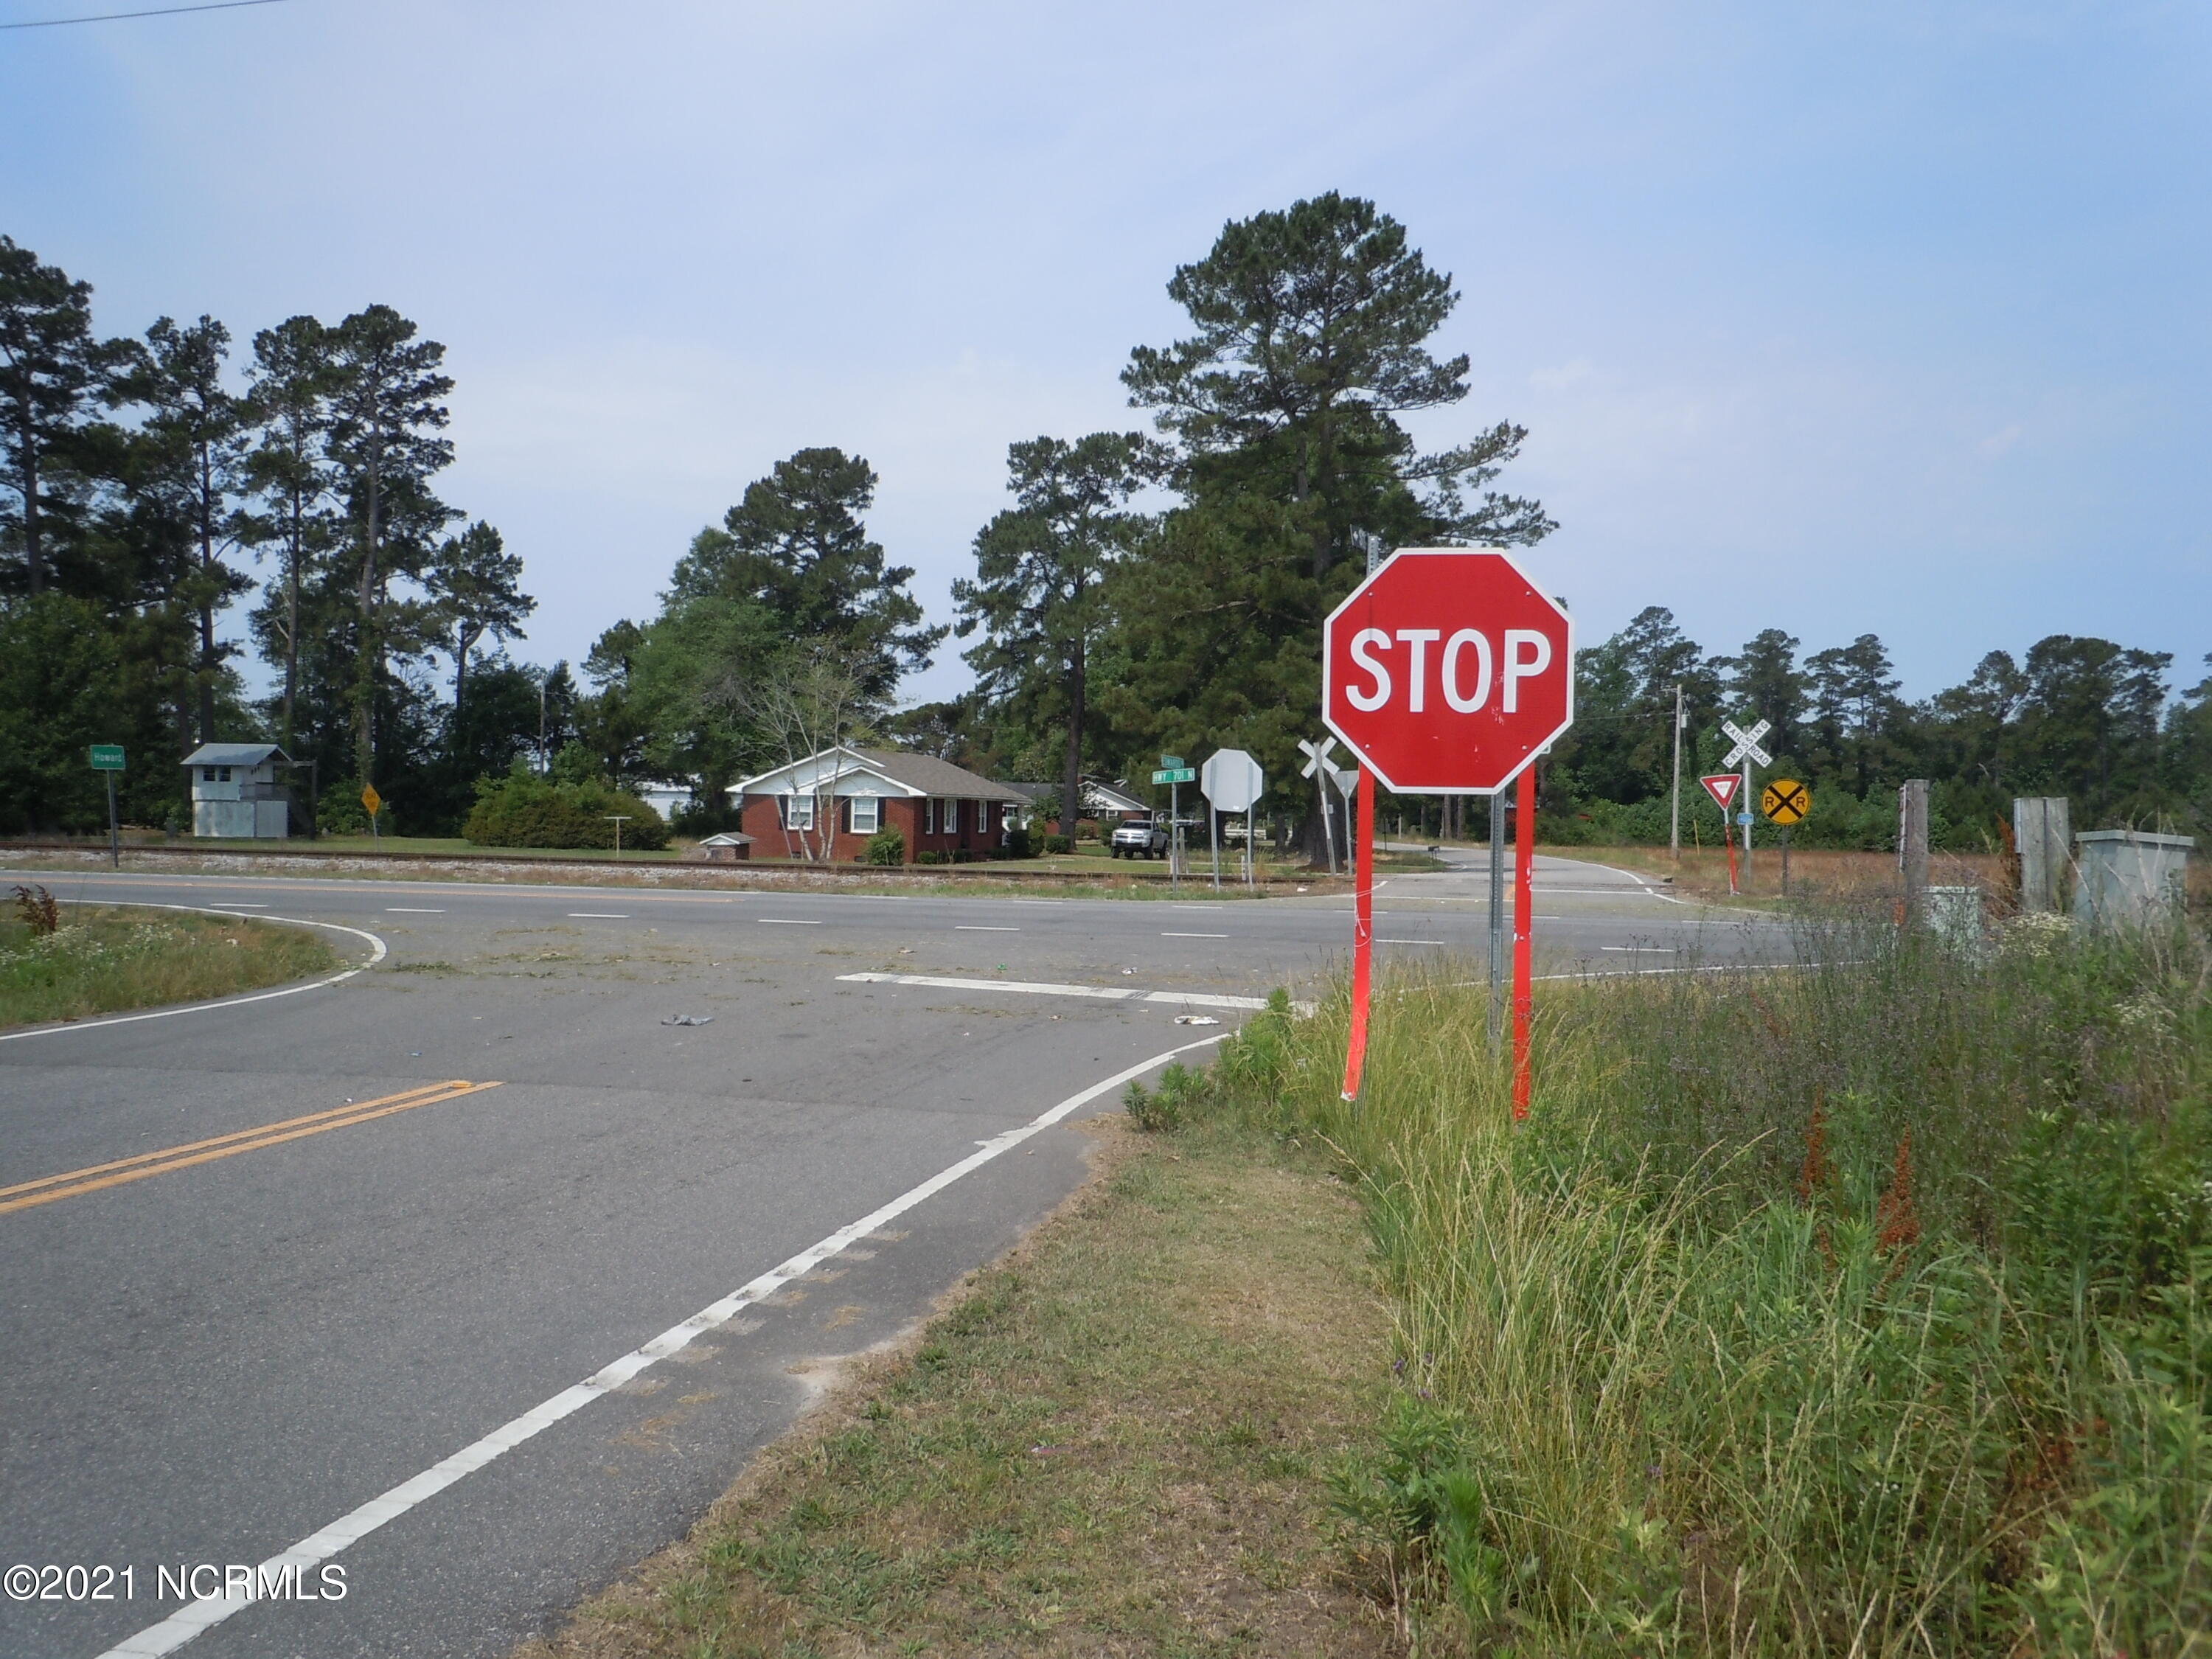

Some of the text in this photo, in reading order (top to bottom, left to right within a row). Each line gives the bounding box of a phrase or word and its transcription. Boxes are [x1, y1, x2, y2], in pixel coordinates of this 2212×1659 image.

[1345, 627, 1552, 714] STOP
[1725, 720, 1769, 765] CROSSING
[1154, 770, 1192, 782] HWY 701 N
[1765, 796, 1806, 807] R R
